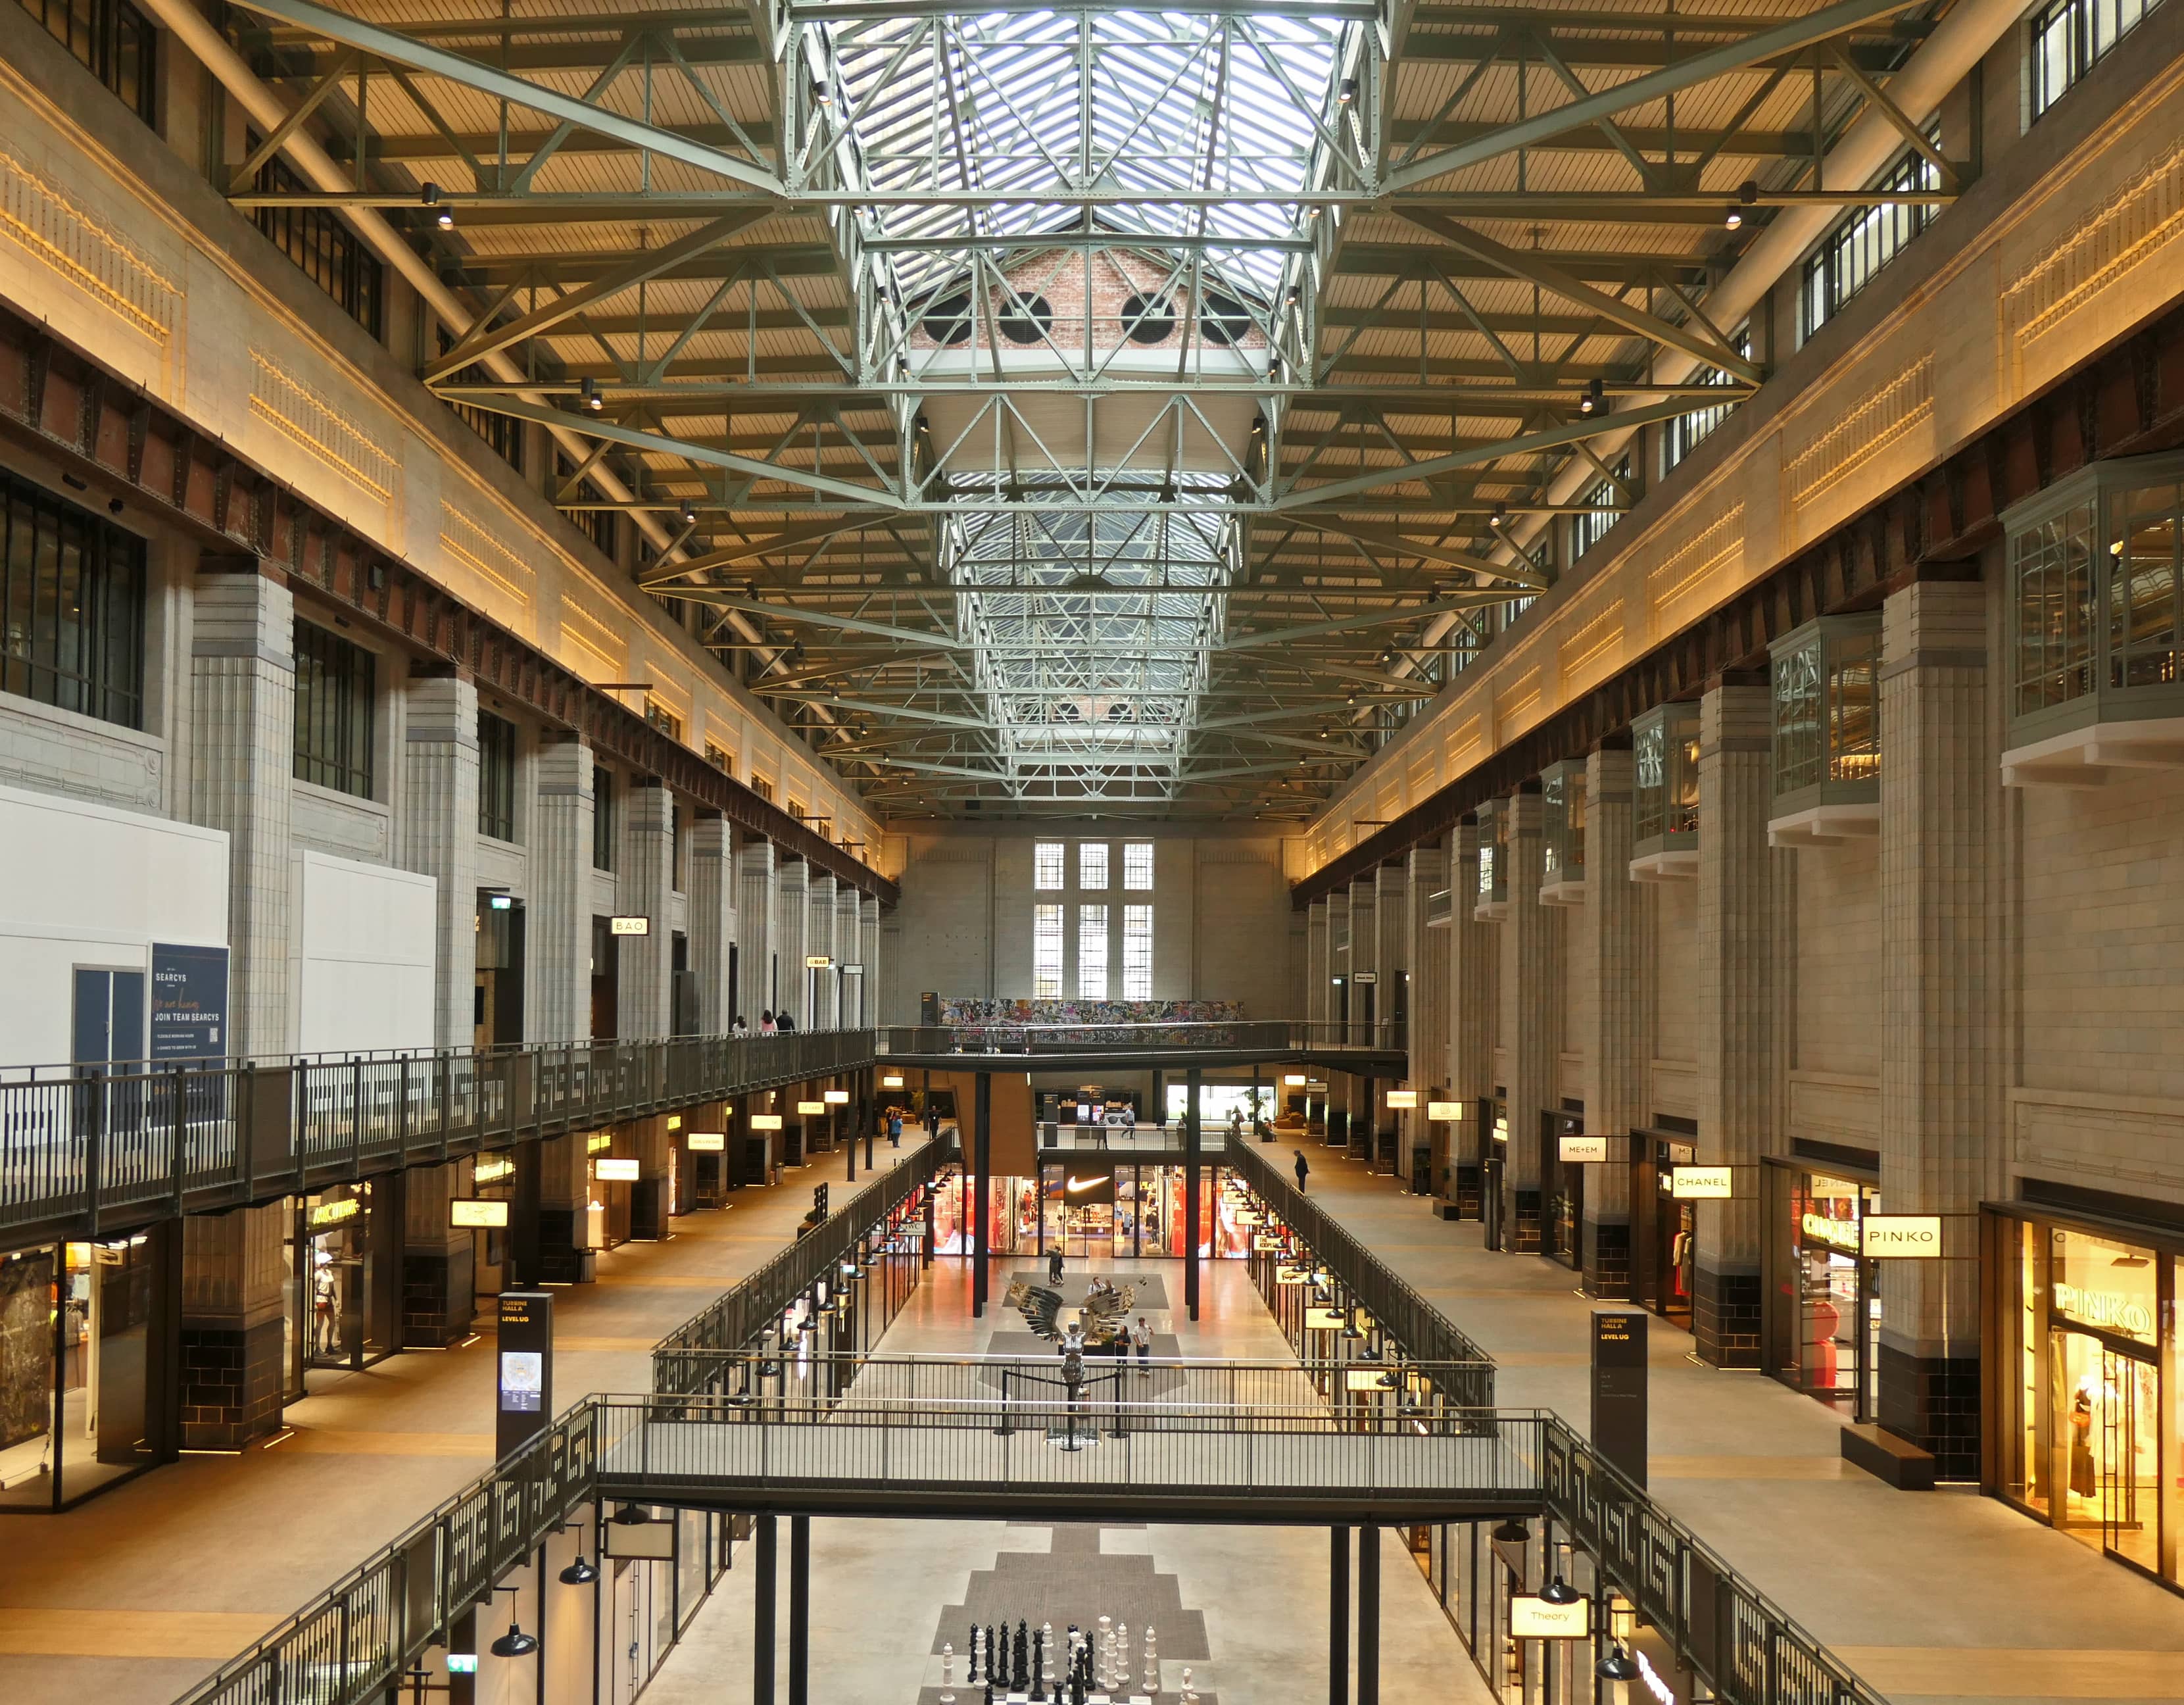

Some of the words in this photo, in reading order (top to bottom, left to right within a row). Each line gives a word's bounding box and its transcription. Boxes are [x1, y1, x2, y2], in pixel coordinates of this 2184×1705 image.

[155, 973, 187, 982] SEARCYS
[155, 1013, 171, 1022] JOIN
[173, 1013, 190, 1022] TEAM
[191, 1013, 220, 1022] SEARCYS
[1869, 1231, 1933, 1243] PINKO
[2055, 1282, 2152, 1333] PINKO
[1530, 1612, 1570, 1622] Theory
